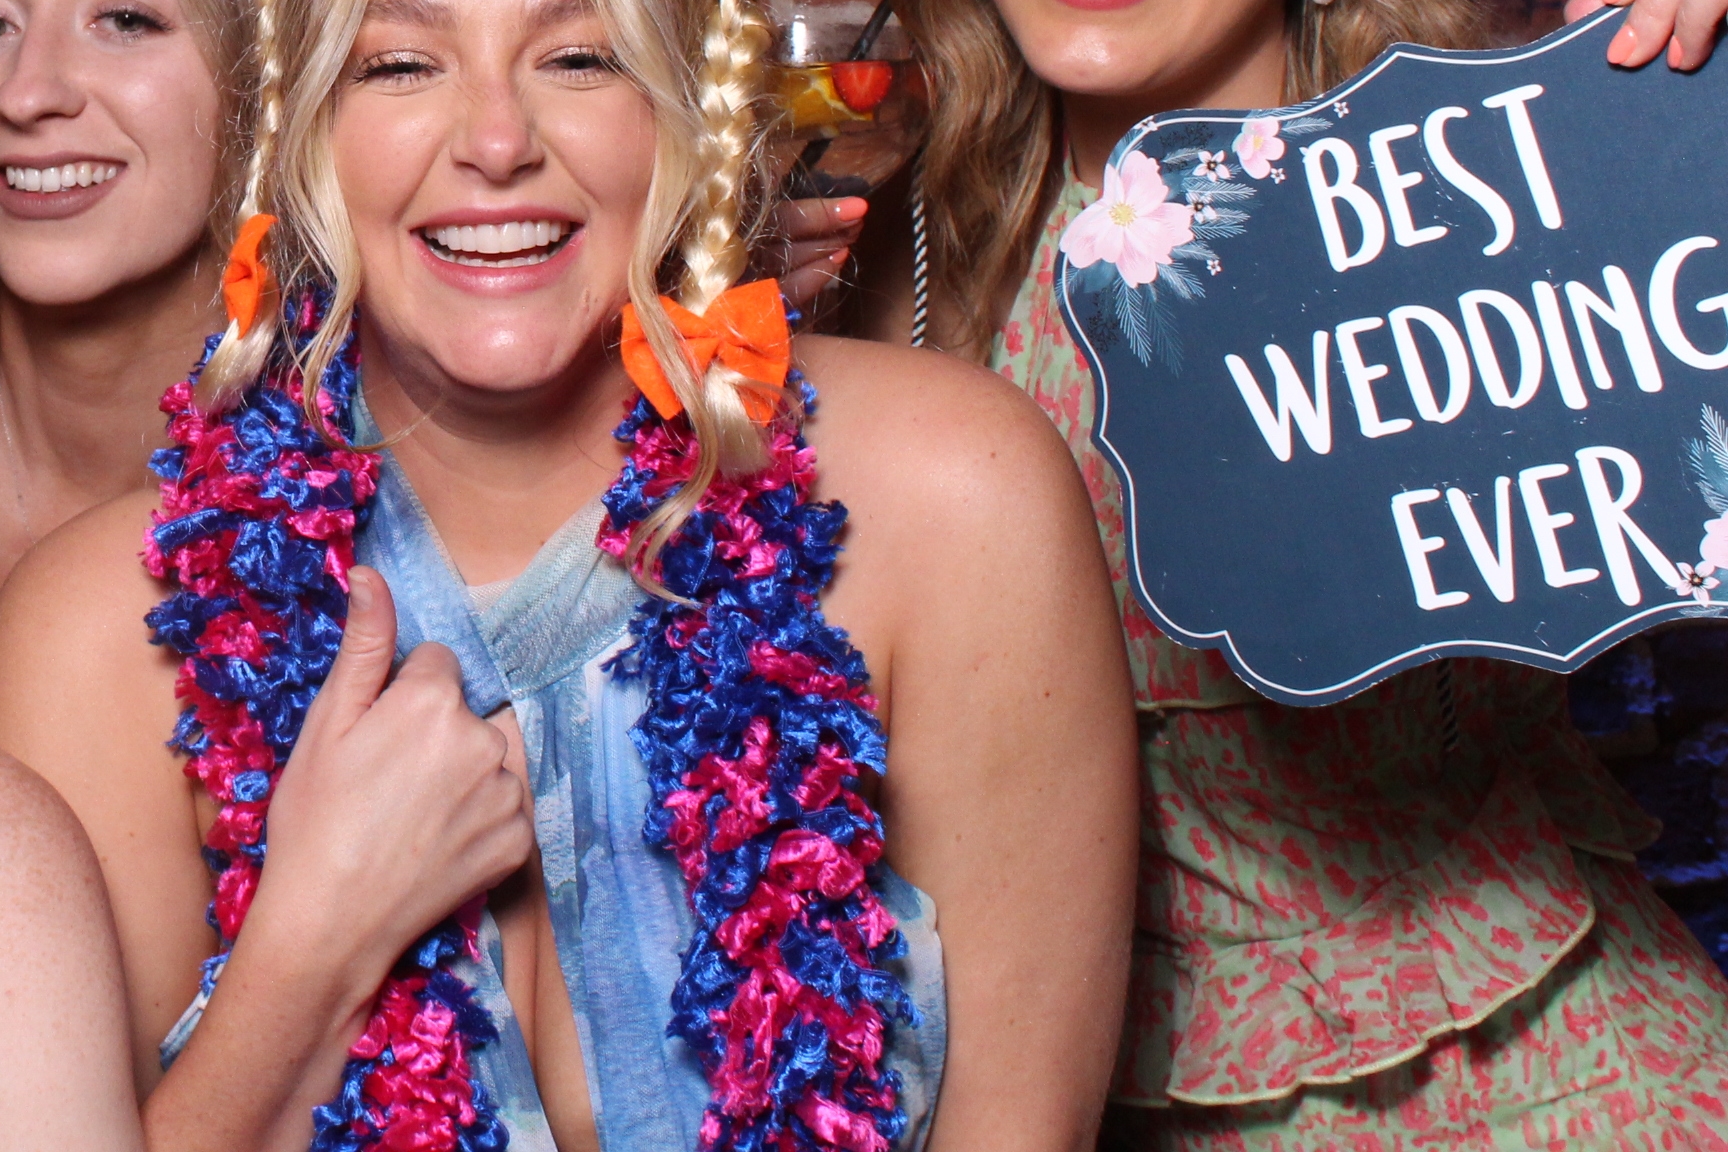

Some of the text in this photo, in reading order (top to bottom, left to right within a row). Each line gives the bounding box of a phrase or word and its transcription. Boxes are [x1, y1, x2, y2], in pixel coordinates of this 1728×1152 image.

[1302, 84, 1562, 272] BEST
[1224, 236, 1728, 461] WEDDING
[1391, 446, 1683, 610] EVER
